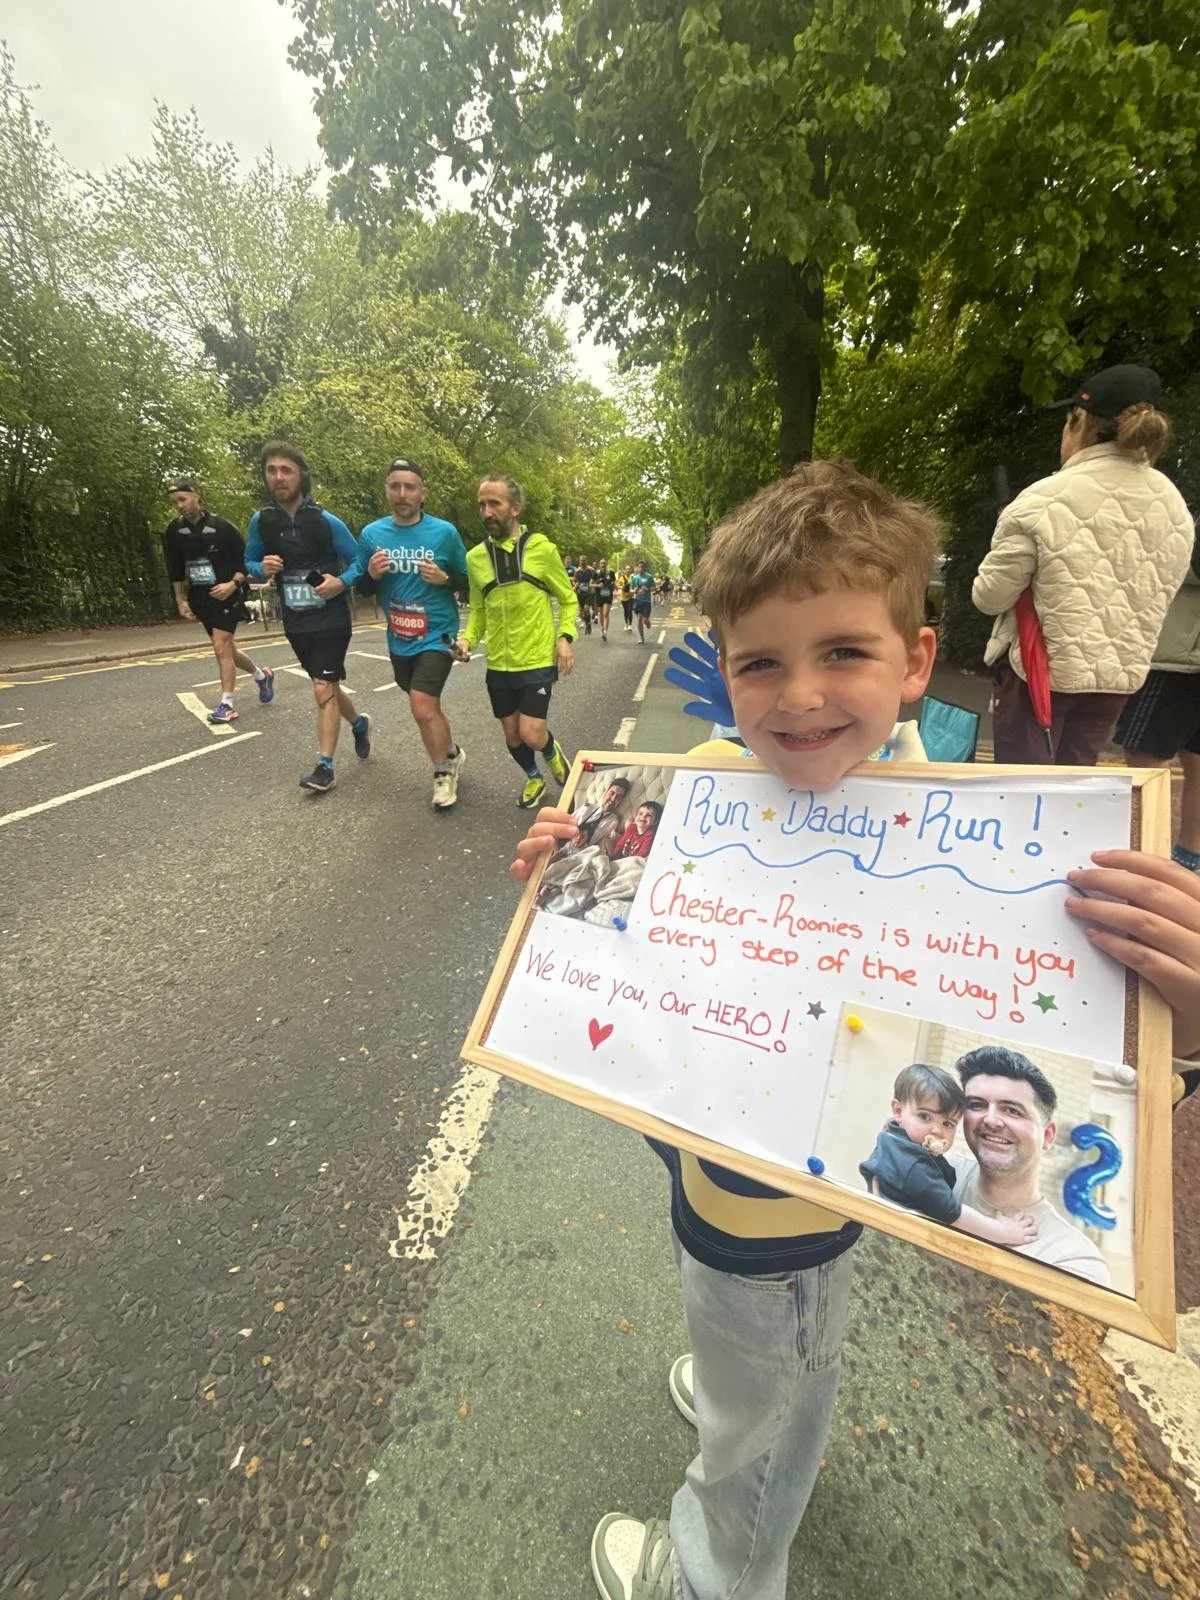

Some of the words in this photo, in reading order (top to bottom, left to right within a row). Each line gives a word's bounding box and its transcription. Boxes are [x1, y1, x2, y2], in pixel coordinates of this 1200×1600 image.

[682, 775, 750, 836] Run
[780, 788, 887, 872] Daddy
[525, 944, 556, 982] We
[560, 959, 601, 993] love
[606, 977, 648, 1010] you,
[647, 925, 717, 967] every
[741, 939, 800, 967] step
[817, 948, 851, 974] of
[861, 954, 918, 987] the
[880, 922, 911, 948] is
[926, 932, 1000, 961] with
[1012, 947, 1077, 987] you
[1062, 1122, 1122, 1231] 2
